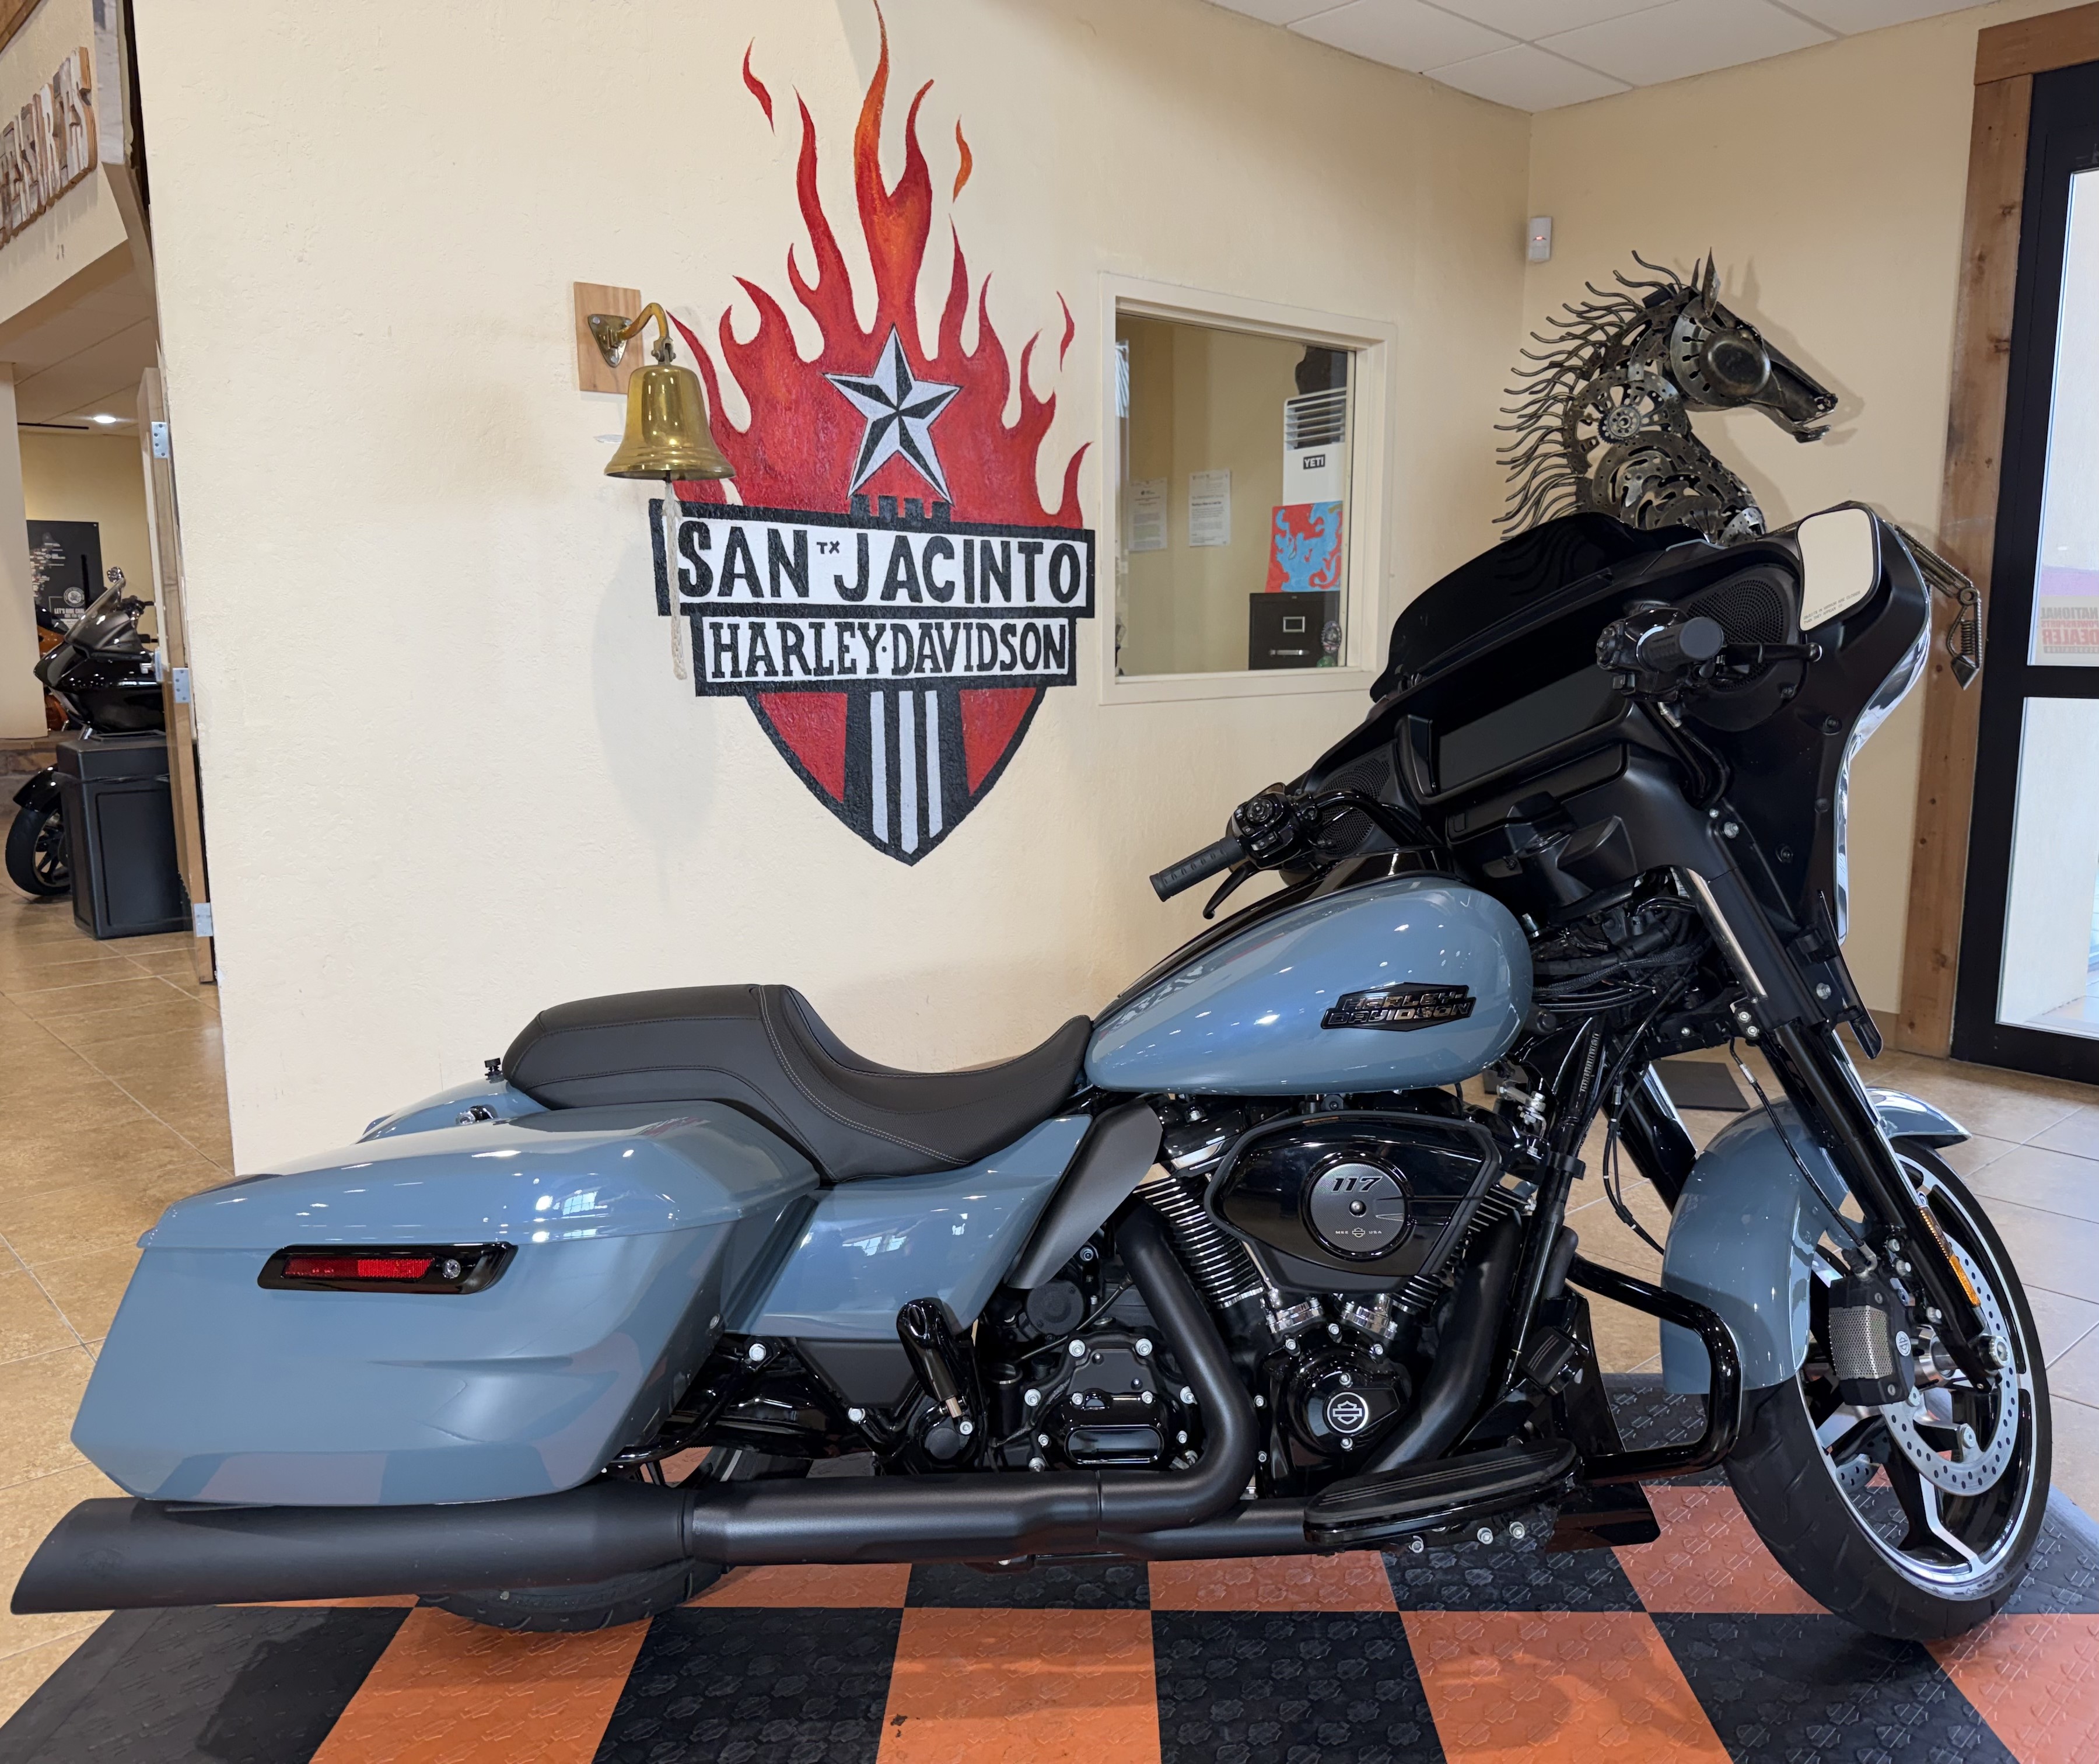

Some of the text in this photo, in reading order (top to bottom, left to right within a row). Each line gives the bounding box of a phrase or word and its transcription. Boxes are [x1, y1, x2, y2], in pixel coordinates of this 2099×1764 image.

[1304, 457, 1324, 467] YETI
[678, 520, 1080, 604] SAN TX JACINTO
[1342, 992, 1464, 1010] HARLEY-
[1328, 1002, 1471, 1025] DAVIDSON
[1331, 1175, 1383, 1193] 117
